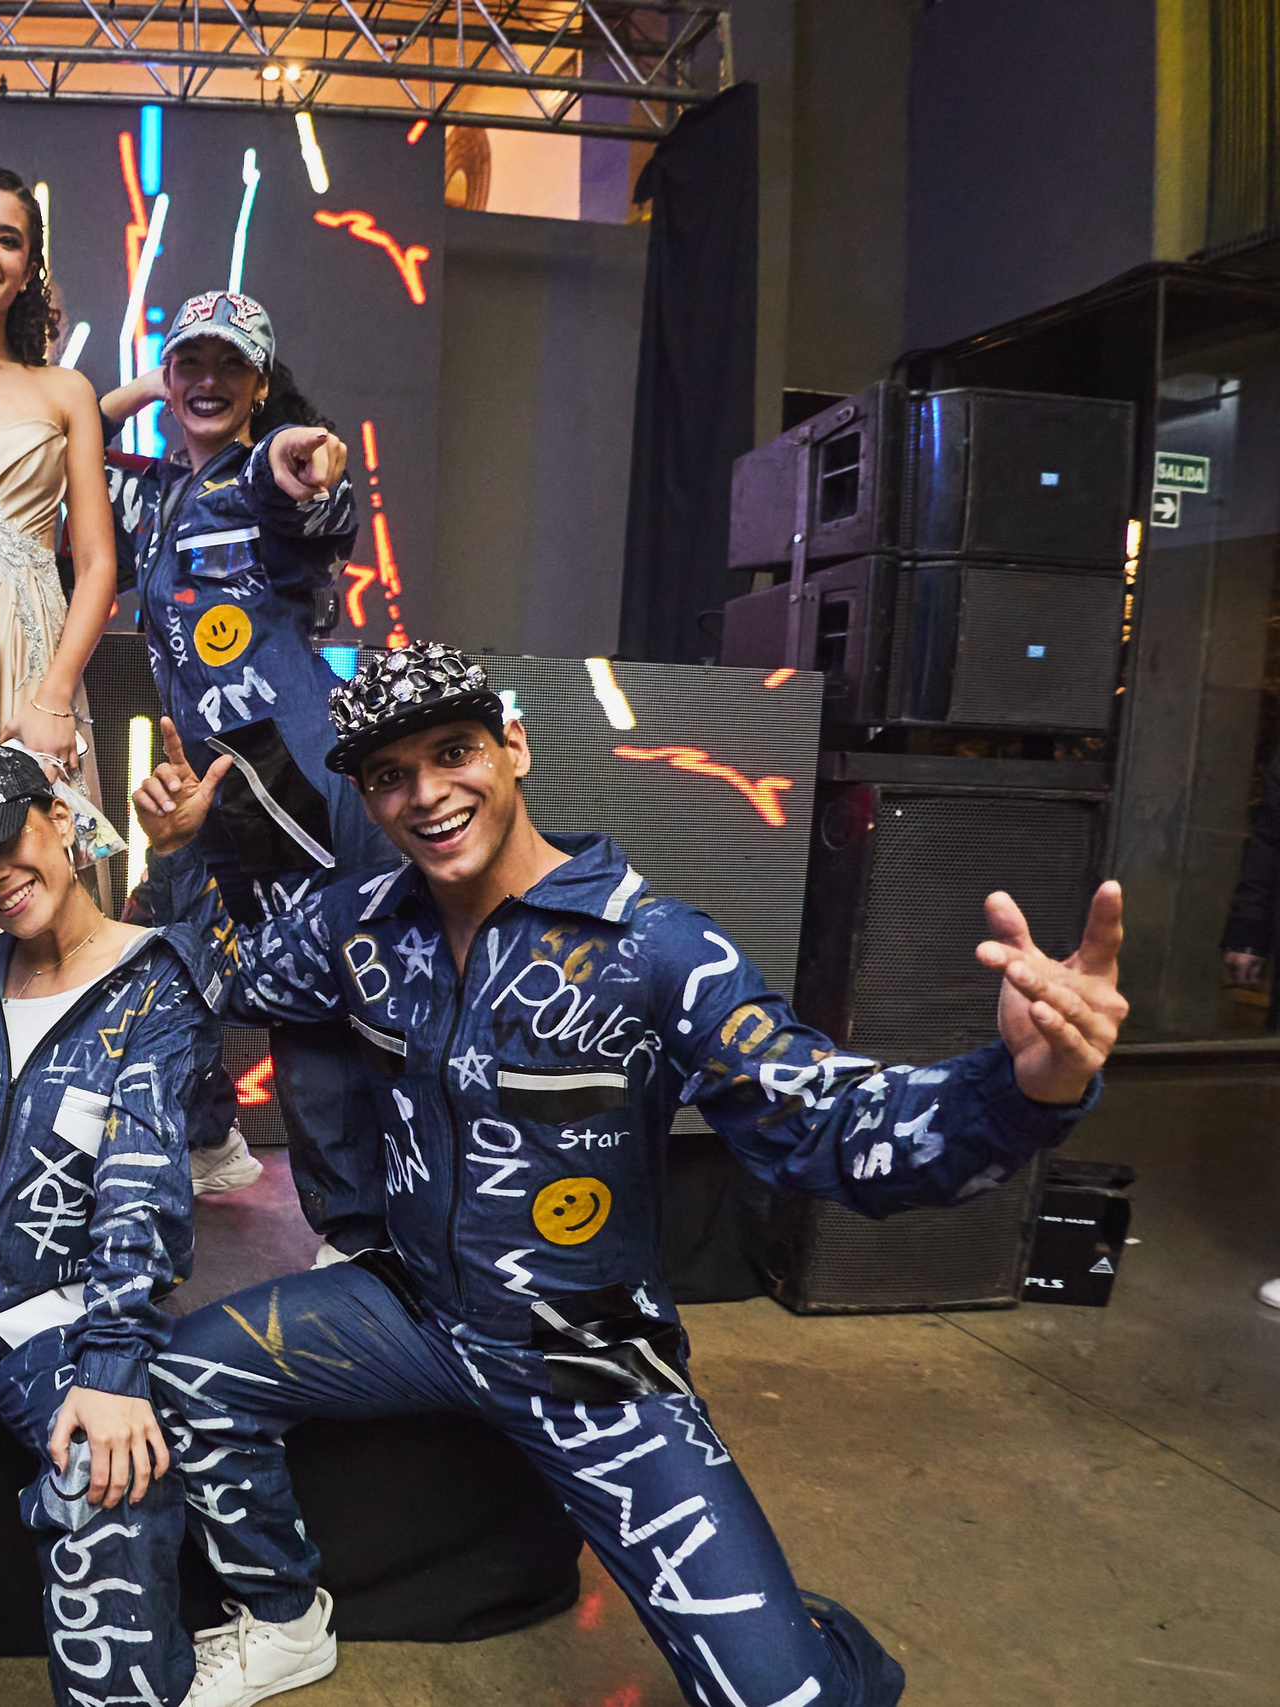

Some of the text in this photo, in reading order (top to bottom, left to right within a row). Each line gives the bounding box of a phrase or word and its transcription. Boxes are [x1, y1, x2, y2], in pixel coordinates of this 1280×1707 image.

[177, 290, 262, 333] NY
[1158, 463, 1204, 482] SALIDA
[1024, 1276, 1065, 1289] PLS
